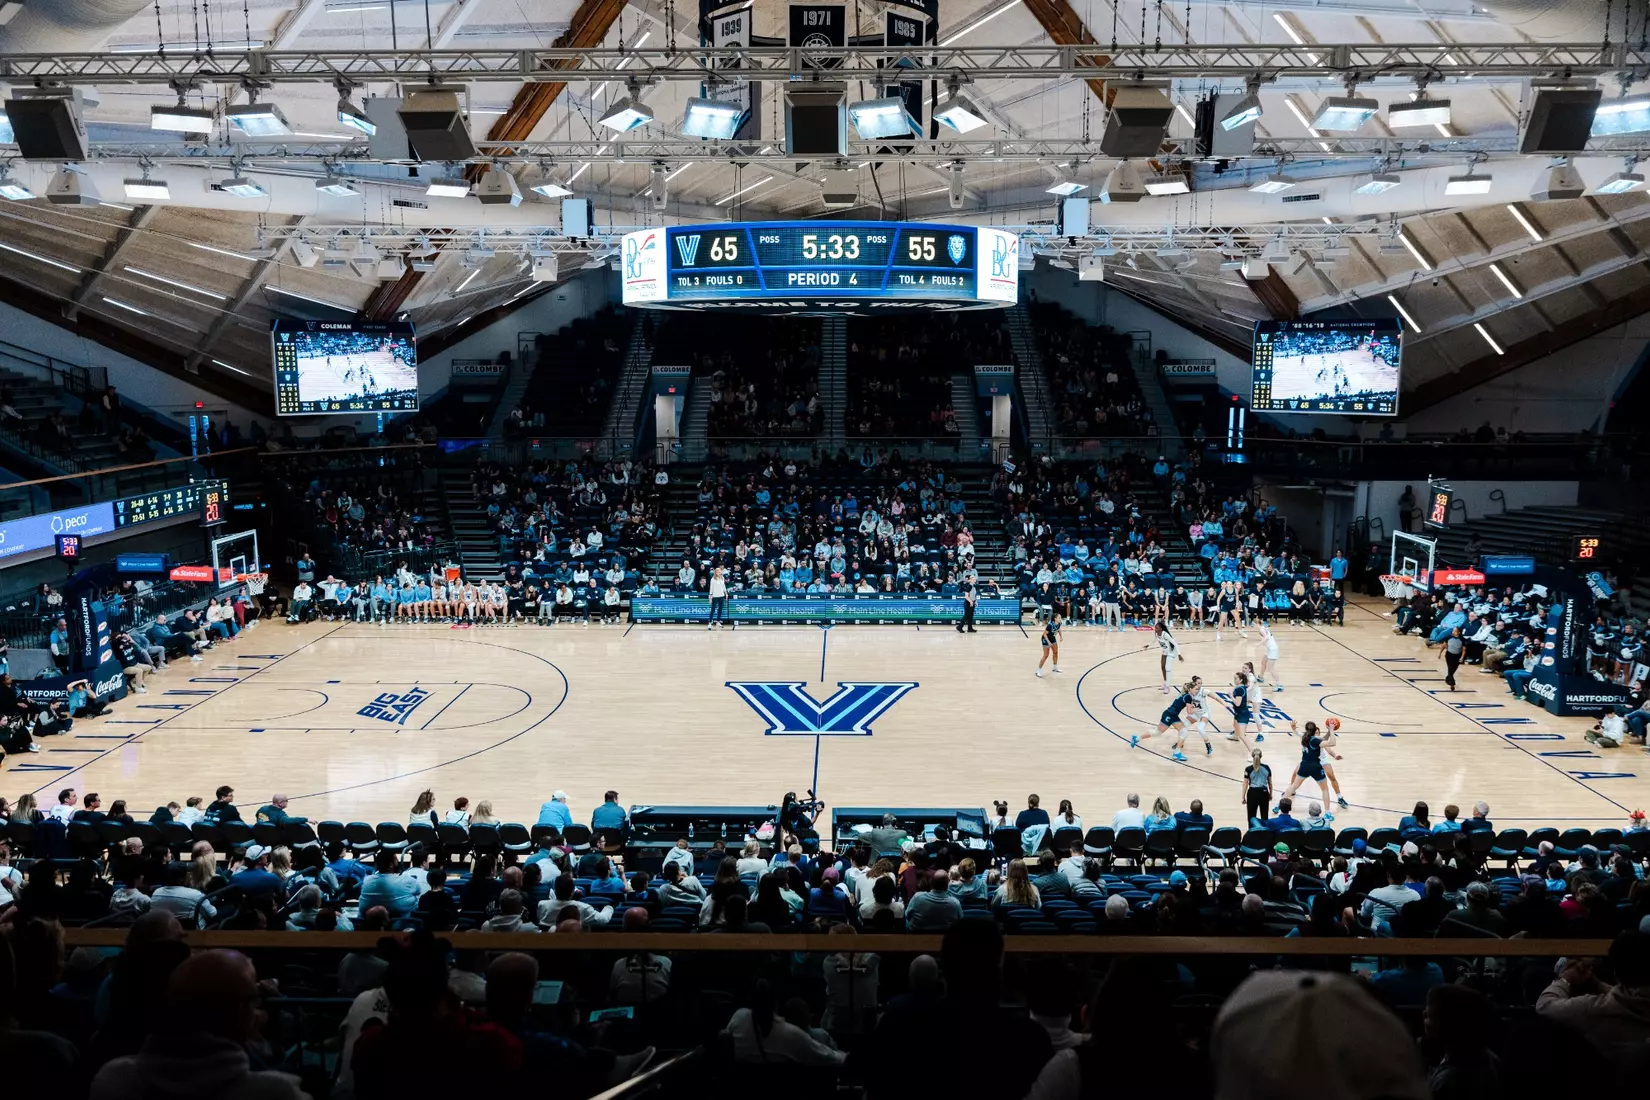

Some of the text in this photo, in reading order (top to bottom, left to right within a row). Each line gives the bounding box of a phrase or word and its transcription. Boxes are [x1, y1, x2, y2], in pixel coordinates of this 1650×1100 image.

[804, 11, 830, 25] 1971
[722, 18, 741, 36] 1939
[894, 19, 916, 38] 1985
[710, 237, 738, 261] 65
[802, 235, 860, 260] 5:33
[908, 236, 936, 261] 55
[678, 276, 699, 286] TOL 3
[706, 276, 742, 286] FOULS 0
[788, 273, 858, 286] PERIOD 4
[899, 275, 924, 284] TOL 4
[932, 276, 963, 285] FOULS 2
[206, 492, 219, 504] 5:33
[206, 504, 218, 522] 20
[66, 515, 87, 532] peco
[1580, 538, 1599, 547] 5:33
[63, 546, 75, 556] 20
[1579, 548, 1593, 558] 20
[356, 693, 400, 718] BIG
[376, 687, 429, 722] EAST
[724, 681, 920, 736] V
